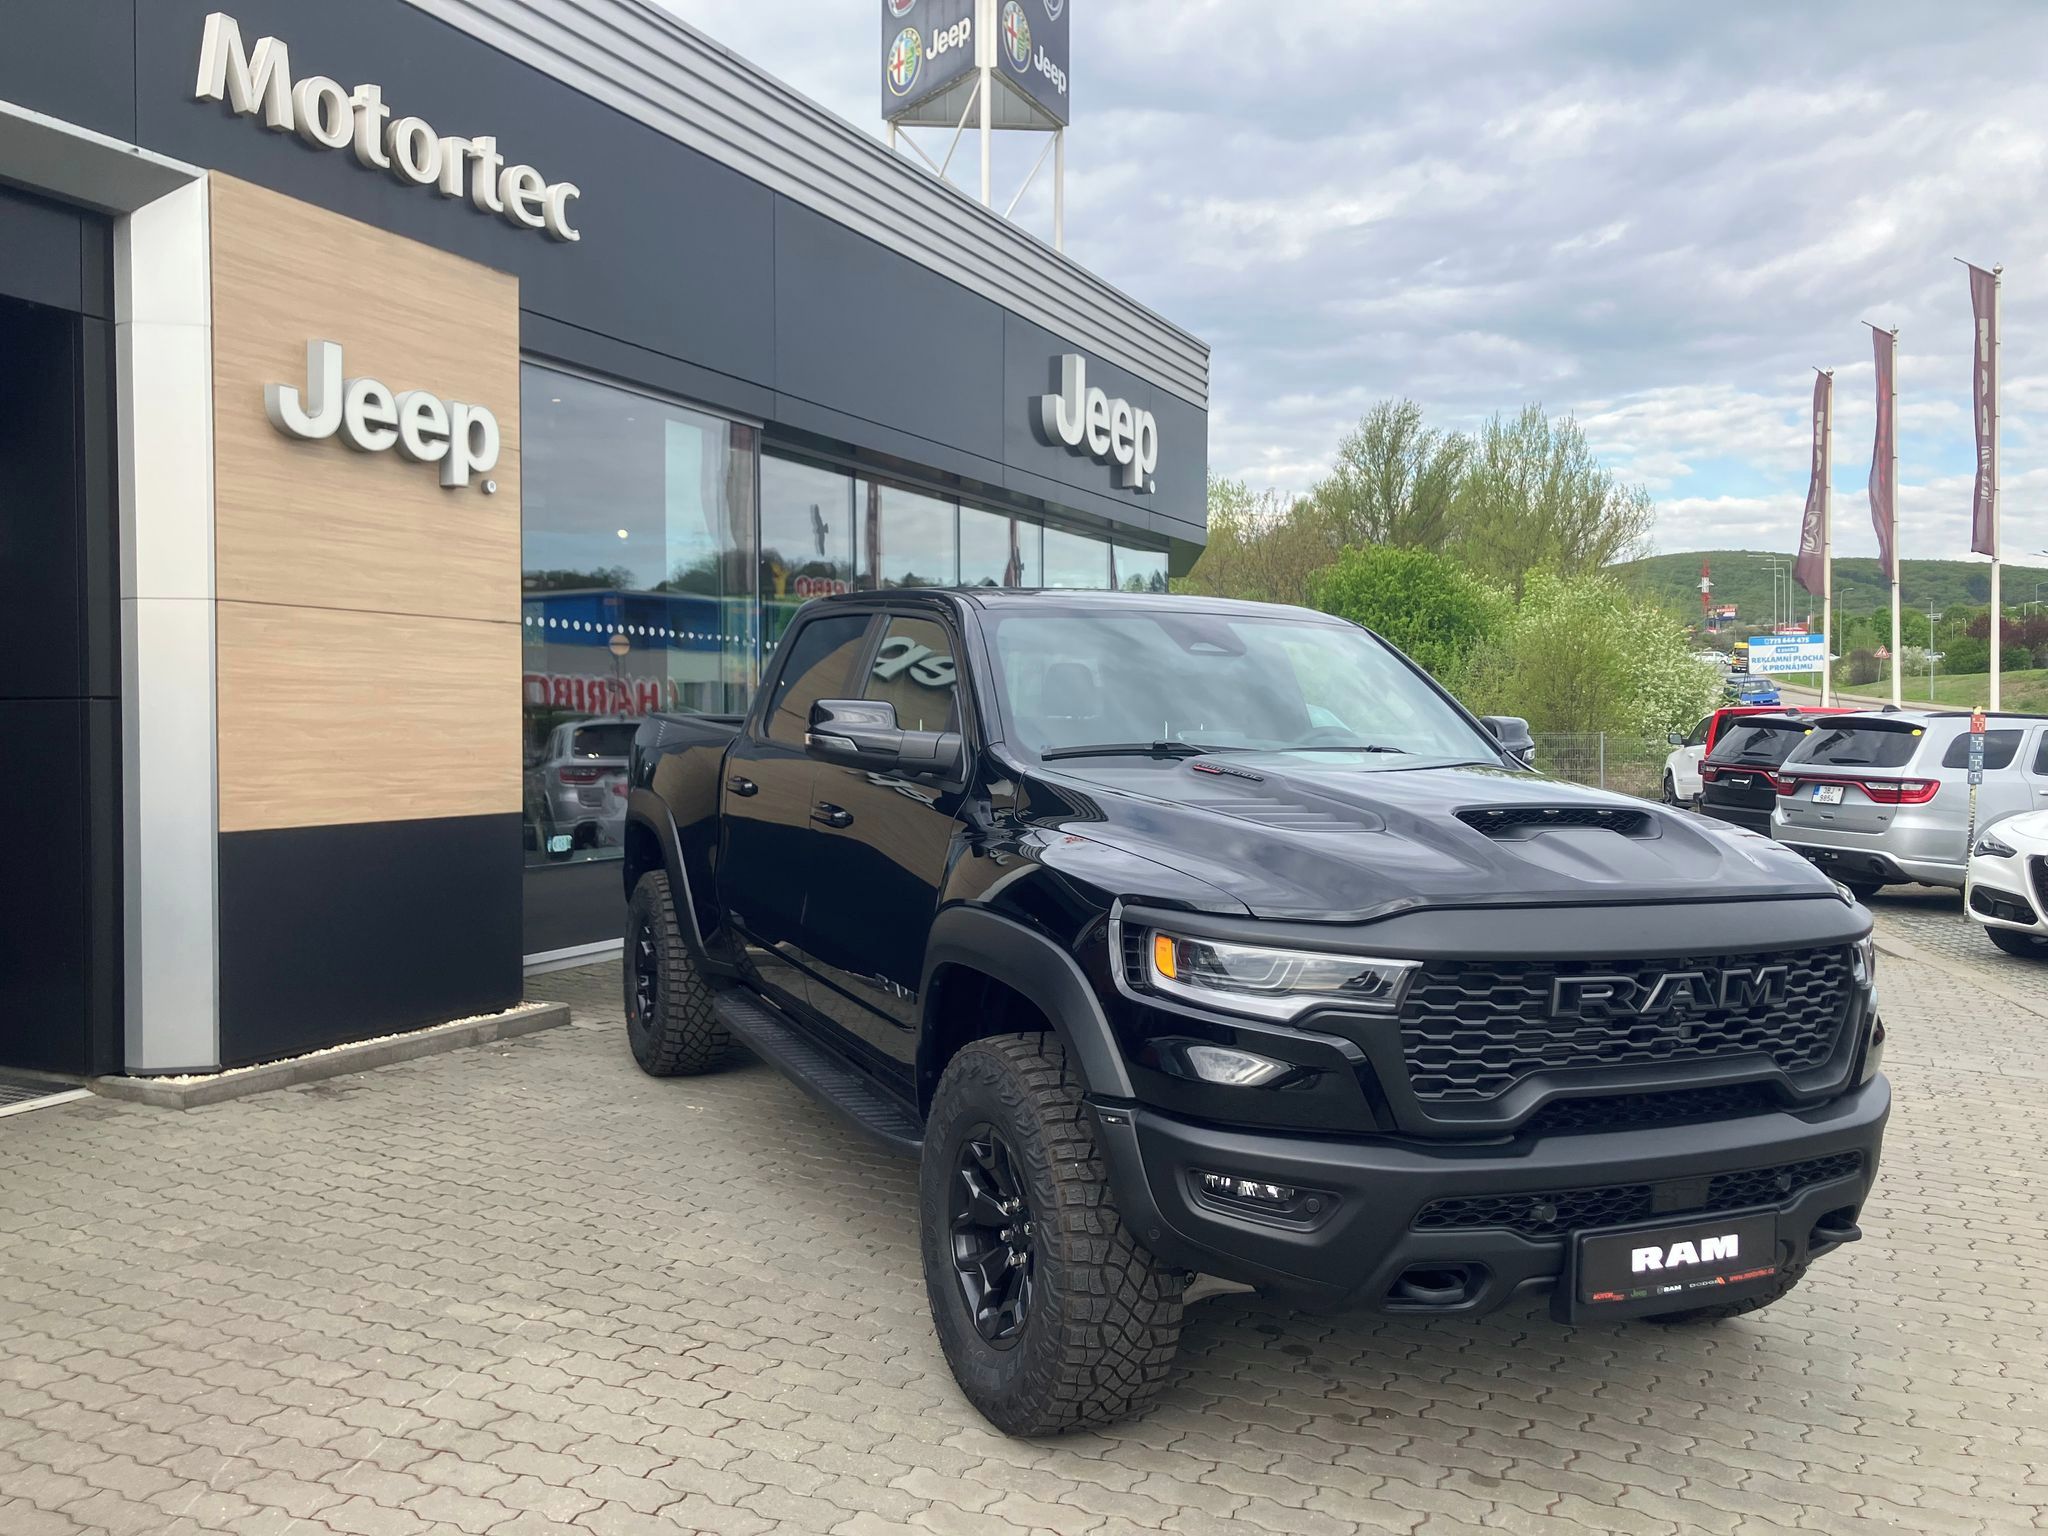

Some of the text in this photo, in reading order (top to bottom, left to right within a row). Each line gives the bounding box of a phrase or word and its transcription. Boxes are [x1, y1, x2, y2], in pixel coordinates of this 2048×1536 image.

[926, 17, 971, 60] Jeep
[1034, 45, 1067, 94] Jeep
[196, 12, 581, 242] Motortec
[264, 337, 500, 491] Jeep
[1041, 353, 1158, 490] Jeep
[1551, 965, 1788, 1018] RAM
[1631, 1234, 1739, 1273] RAM
[1663, 1284, 1682, 1293] RAM
